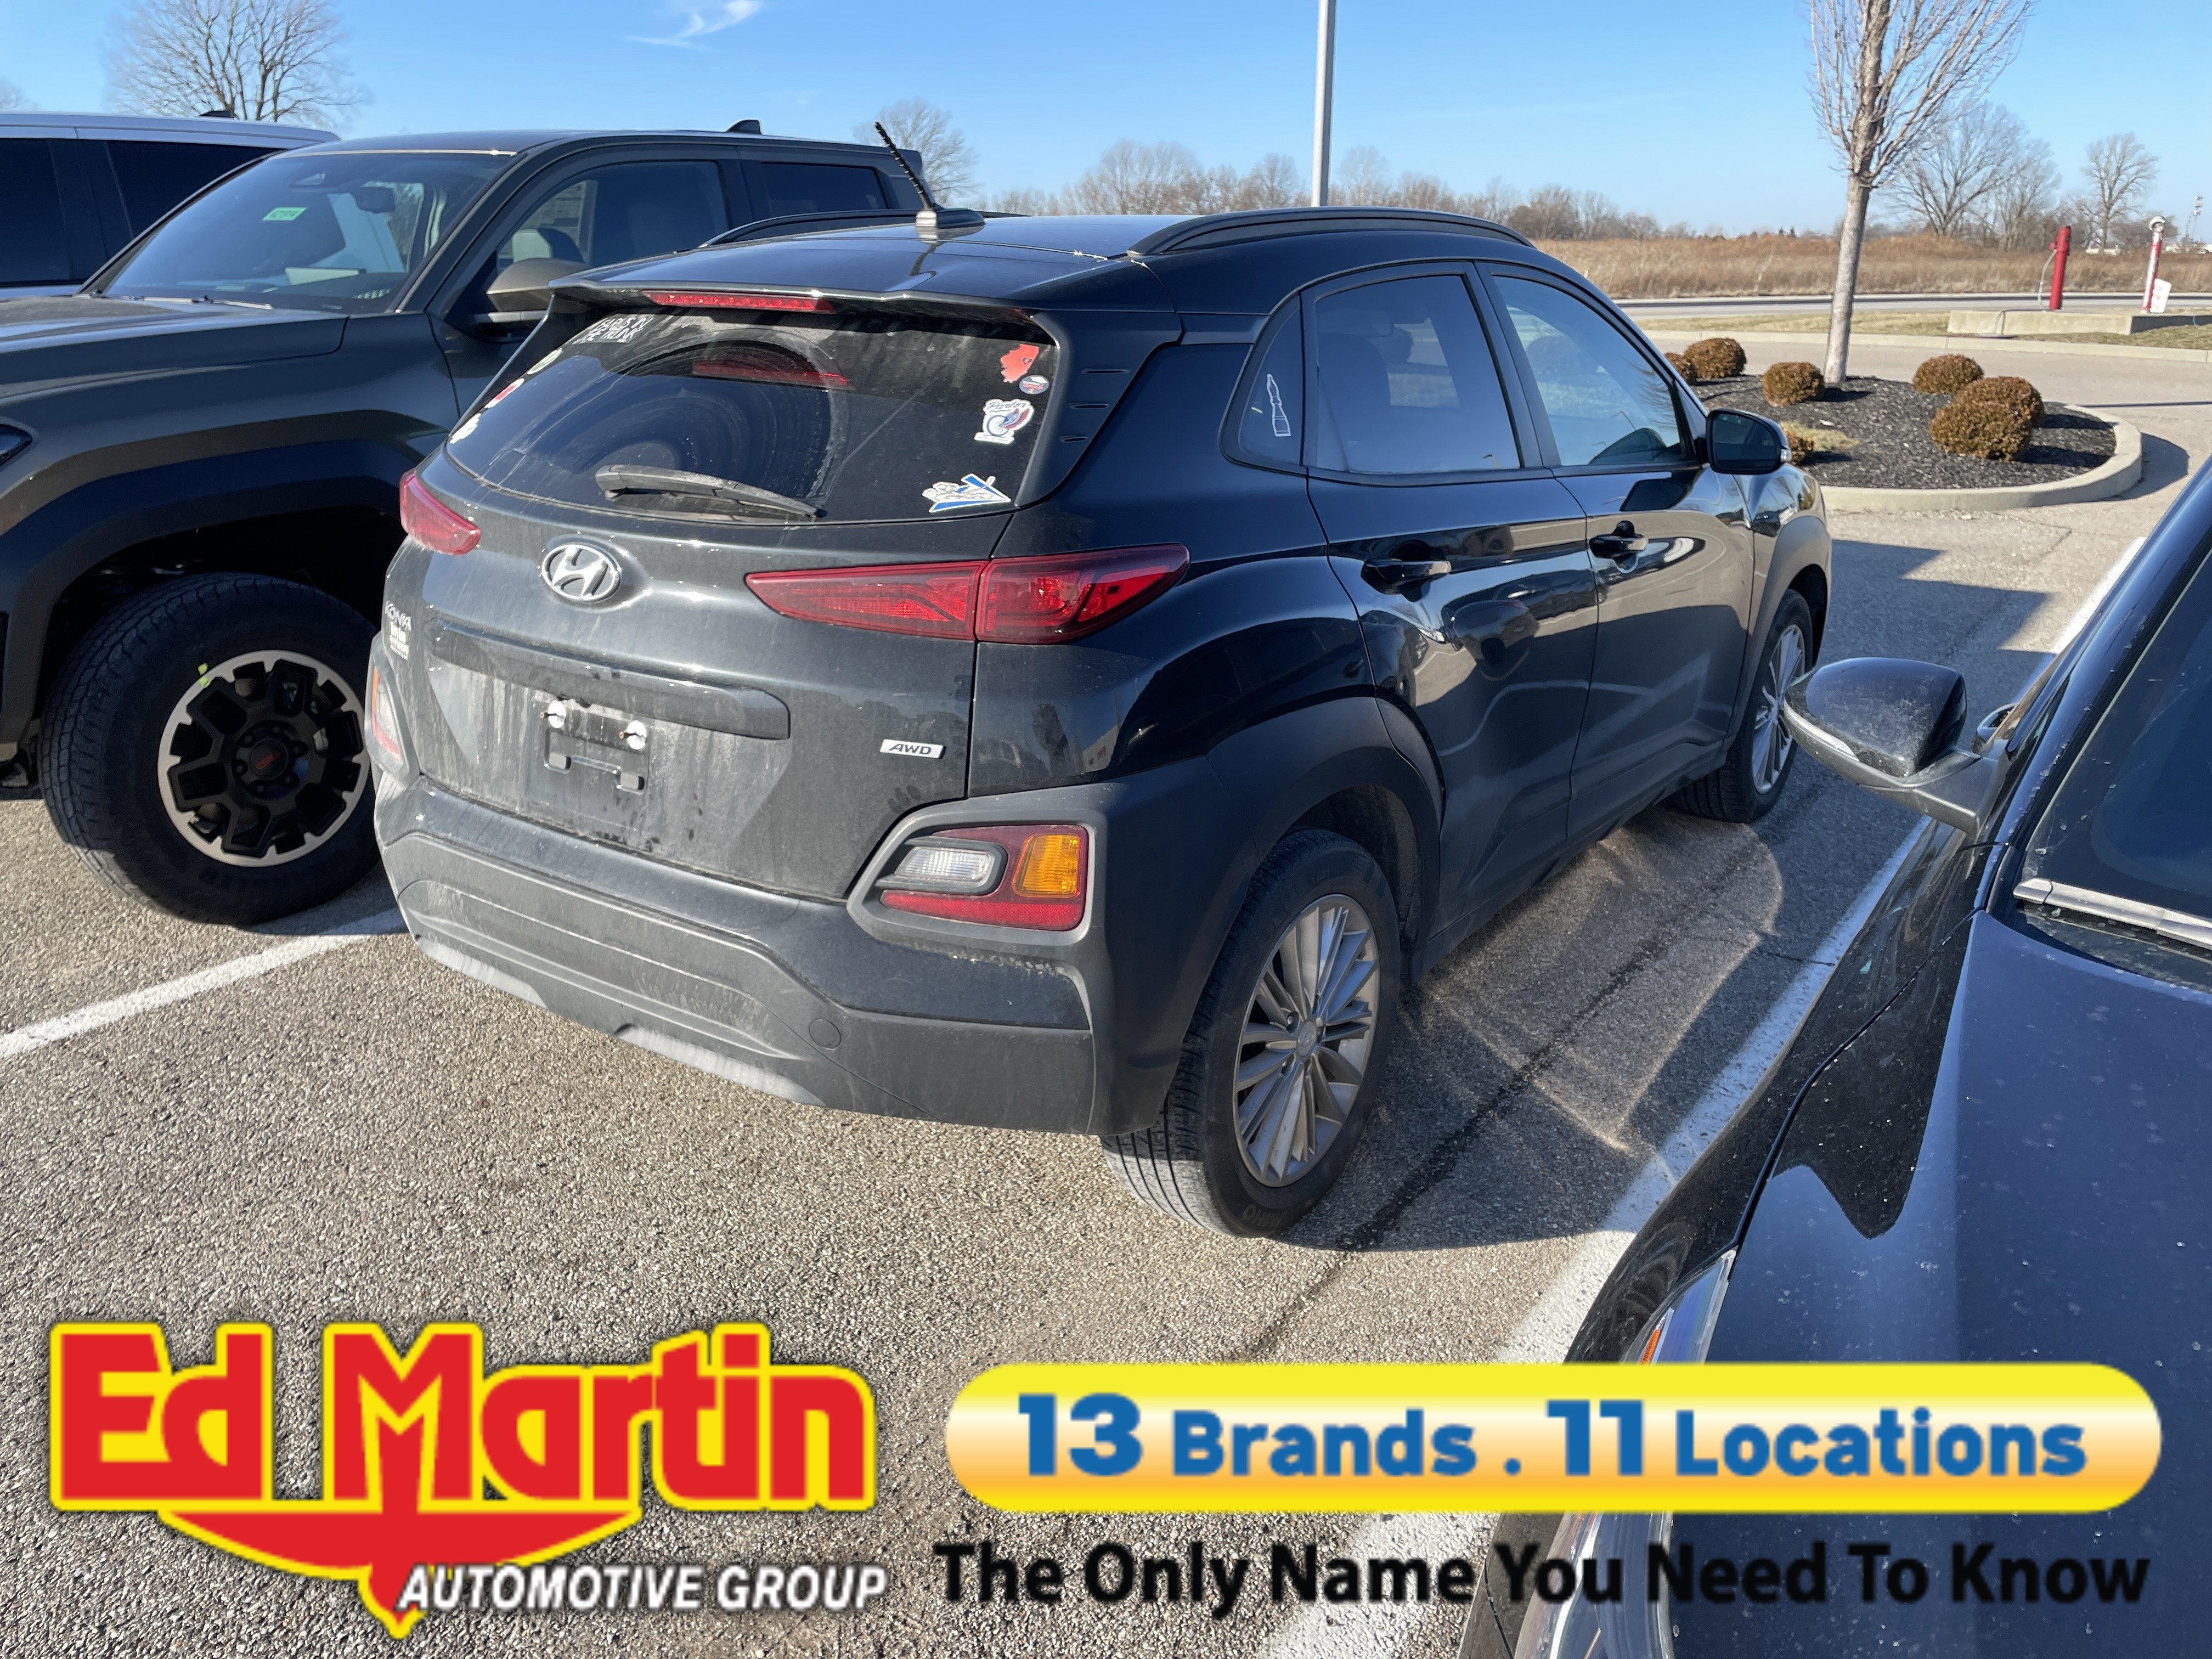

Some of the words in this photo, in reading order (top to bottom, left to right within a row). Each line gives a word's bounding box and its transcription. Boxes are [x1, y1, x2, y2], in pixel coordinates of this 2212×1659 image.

[599, 328, 644, 340] TRUNK
[385, 600, 412, 631] KONA
[888, 743, 932, 755] AWD
